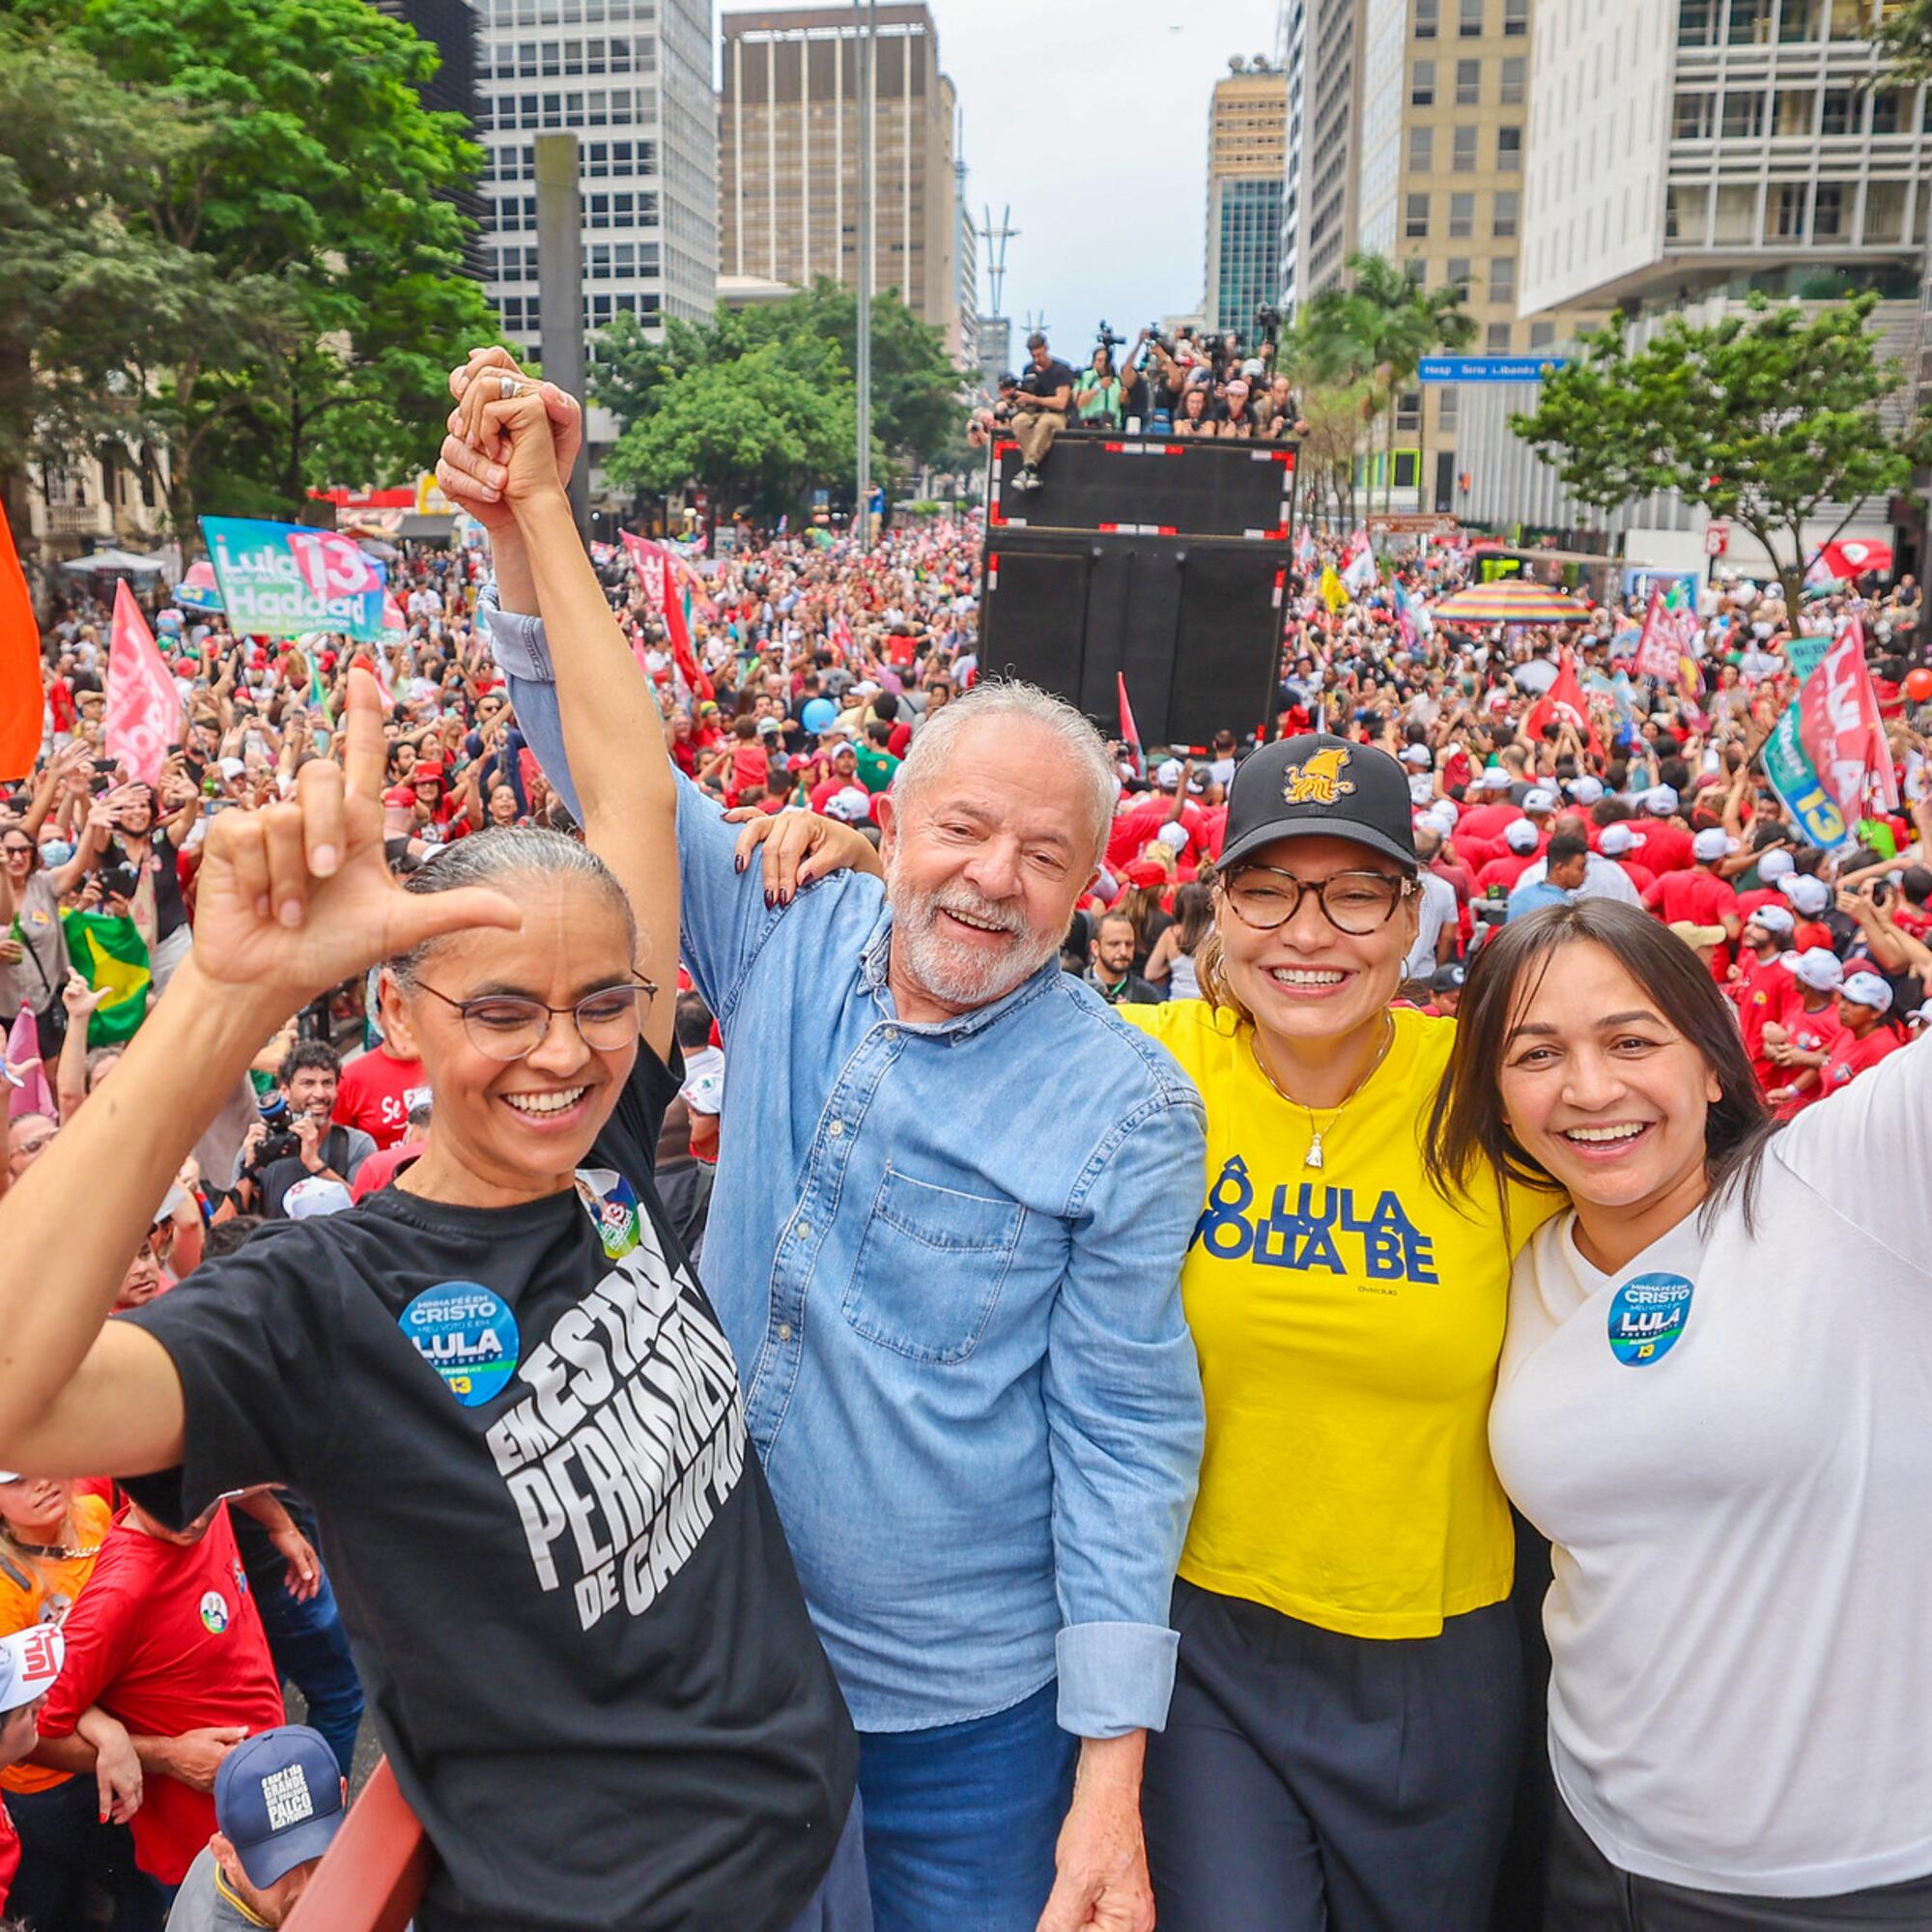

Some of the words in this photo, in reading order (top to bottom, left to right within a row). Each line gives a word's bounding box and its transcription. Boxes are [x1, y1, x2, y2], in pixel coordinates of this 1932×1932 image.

[216, 545, 301, 578] Lula
[295, 534, 369, 590] 13
[225, 584, 365, 625] Haddad
[1796, 787, 1845, 841] 13
[1270, 1182, 1420, 1235] LULA
[410, 1300, 497, 1325] CRISTO
[1624, 1289, 1690, 1304] CRISTO
[1621, 1307, 1681, 1332] LULA
[412, 1328, 502, 1360] LULA
[447, 1376, 472, 1394] 13
[486, 1397, 561, 1477] EM
[574, 1559, 620, 1632] DE
[263, 1773, 306, 1800] GRANDE
[269, 1792, 312, 1824] PALCO
